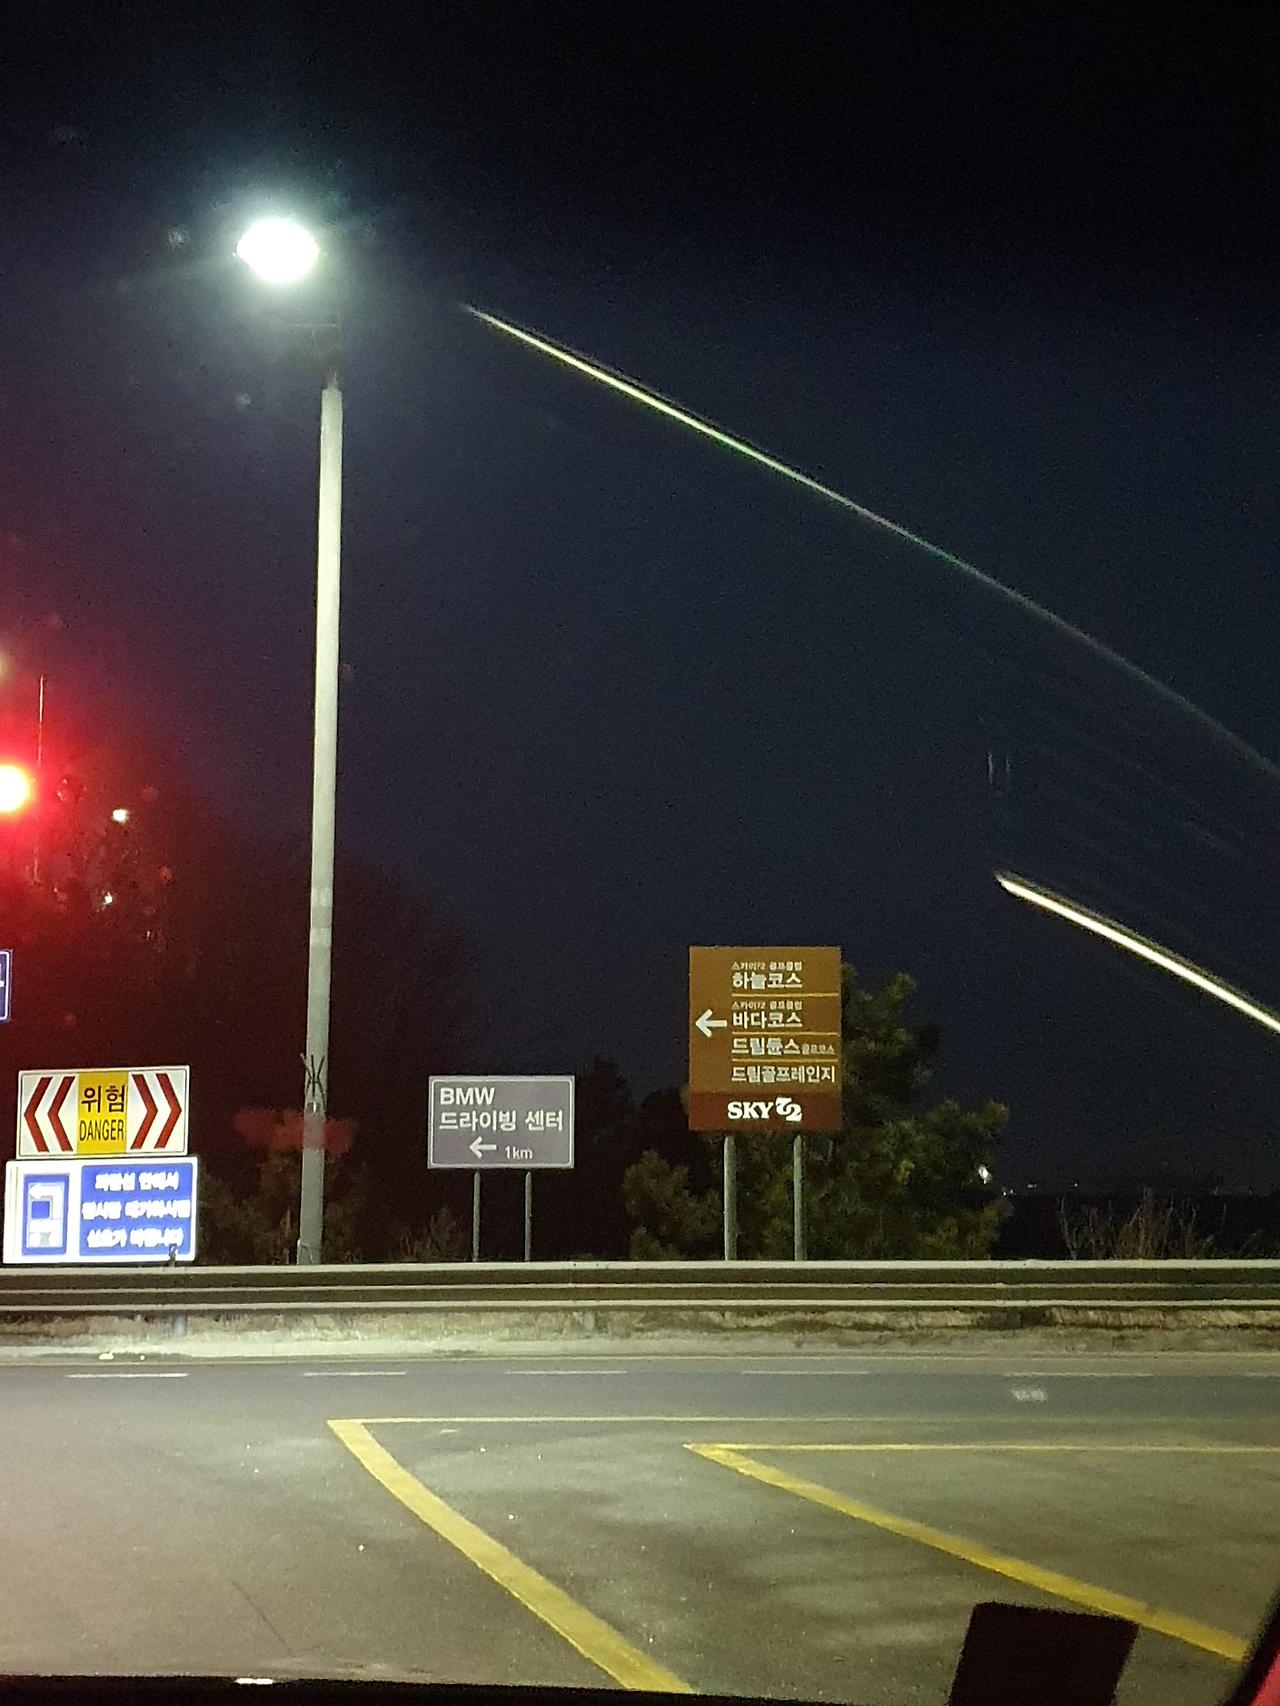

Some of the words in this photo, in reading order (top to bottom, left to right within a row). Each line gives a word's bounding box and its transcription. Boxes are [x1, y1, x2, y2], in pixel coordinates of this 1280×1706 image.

[732, 972, 803, 989] 하늘코스
[732, 1011, 803, 1029] 바다코스
[731, 1066, 836, 1083] 드림골프레인지
[81, 1085, 125, 1113] 위험
[440, 1086, 495, 1105] BMW
[439, 1110, 517, 1131] 드라이빙
[525, 1109, 563, 1131] 센터
[79, 1119, 124, 1141] DANGER
[505, 1145, 533, 1159] 1km
